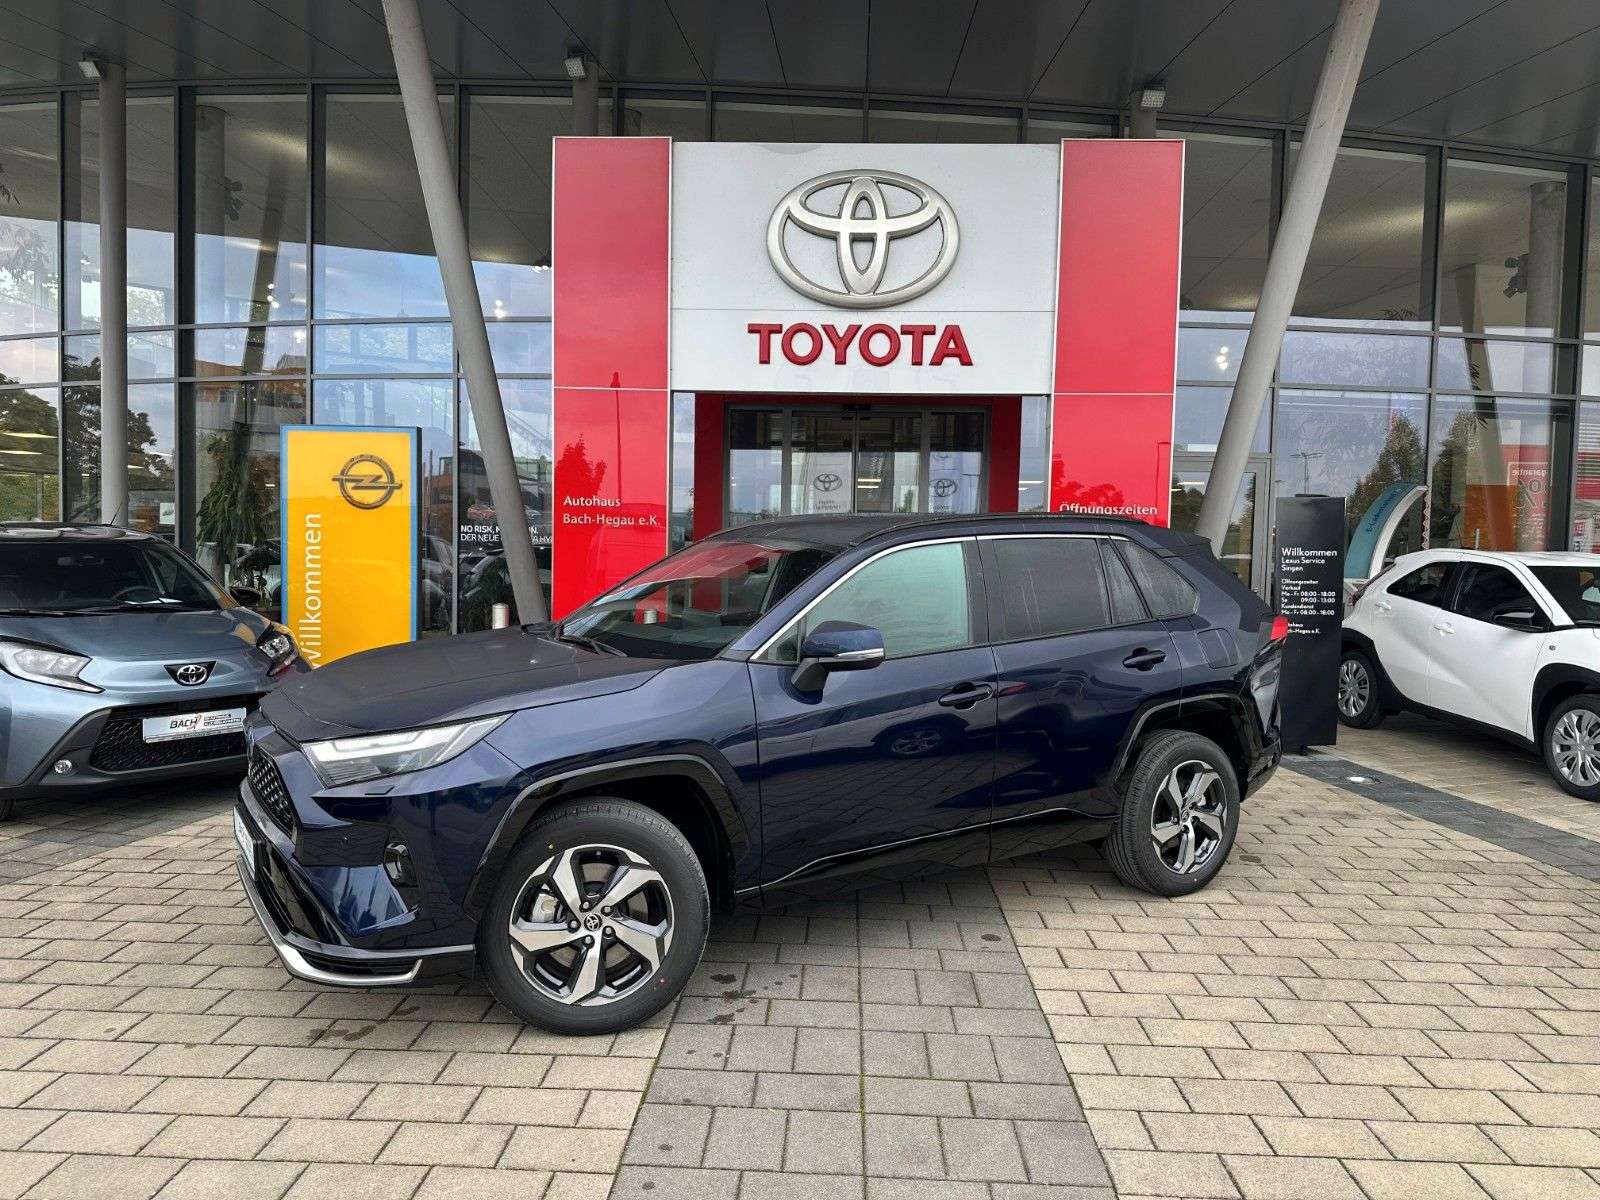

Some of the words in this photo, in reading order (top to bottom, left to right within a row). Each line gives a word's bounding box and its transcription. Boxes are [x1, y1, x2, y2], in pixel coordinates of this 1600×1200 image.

[748, 323, 973, 367] TOYOTA
[563, 496, 621, 507] Autohaus
[1060, 501, 1158, 515] Öffnungszeiten
[563, 513, 634, 528] Bach-Hegau
[638, 515, 660, 526] e.K.
[460, 525, 473, 533] NO
[474, 525, 495, 534] RISK,
[460, 533, 477, 541] DER
[478, 533, 500, 542] NEUE
[1281, 547, 1338, 557] Willkommen
[1281, 556, 1300, 564] Lexus
[1301, 556, 1326, 564] Service
[1281, 564, 1304, 573] Singen
[170, 718, 198, 730] BACH
